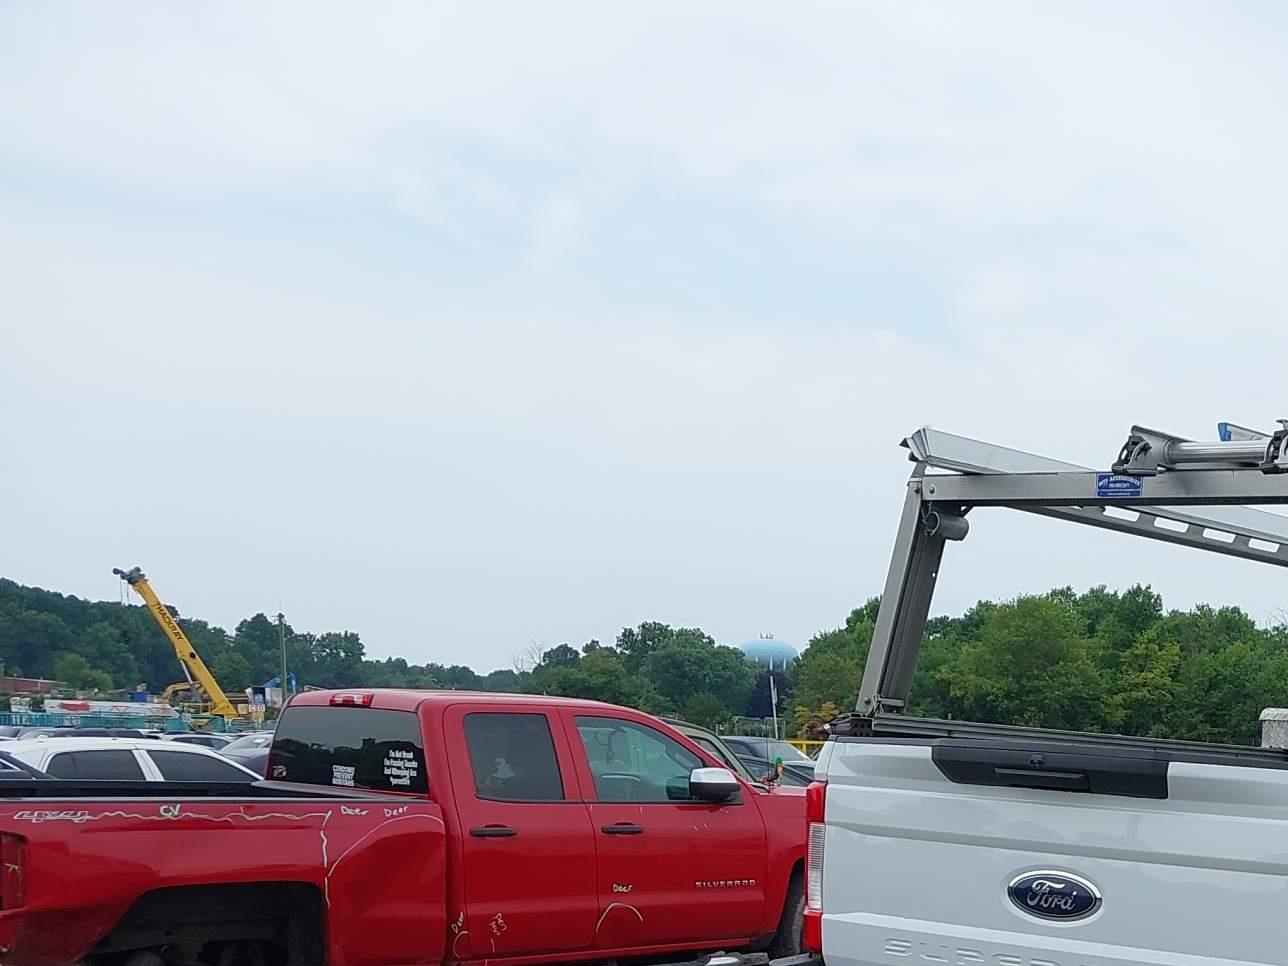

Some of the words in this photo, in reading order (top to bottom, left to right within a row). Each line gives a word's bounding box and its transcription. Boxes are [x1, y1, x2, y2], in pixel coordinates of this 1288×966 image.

[151, 602, 184, 640] THACKRAY
[695, 879, 756, 888] SILVERADO
[1026, 879, 1078, 911] Ford
